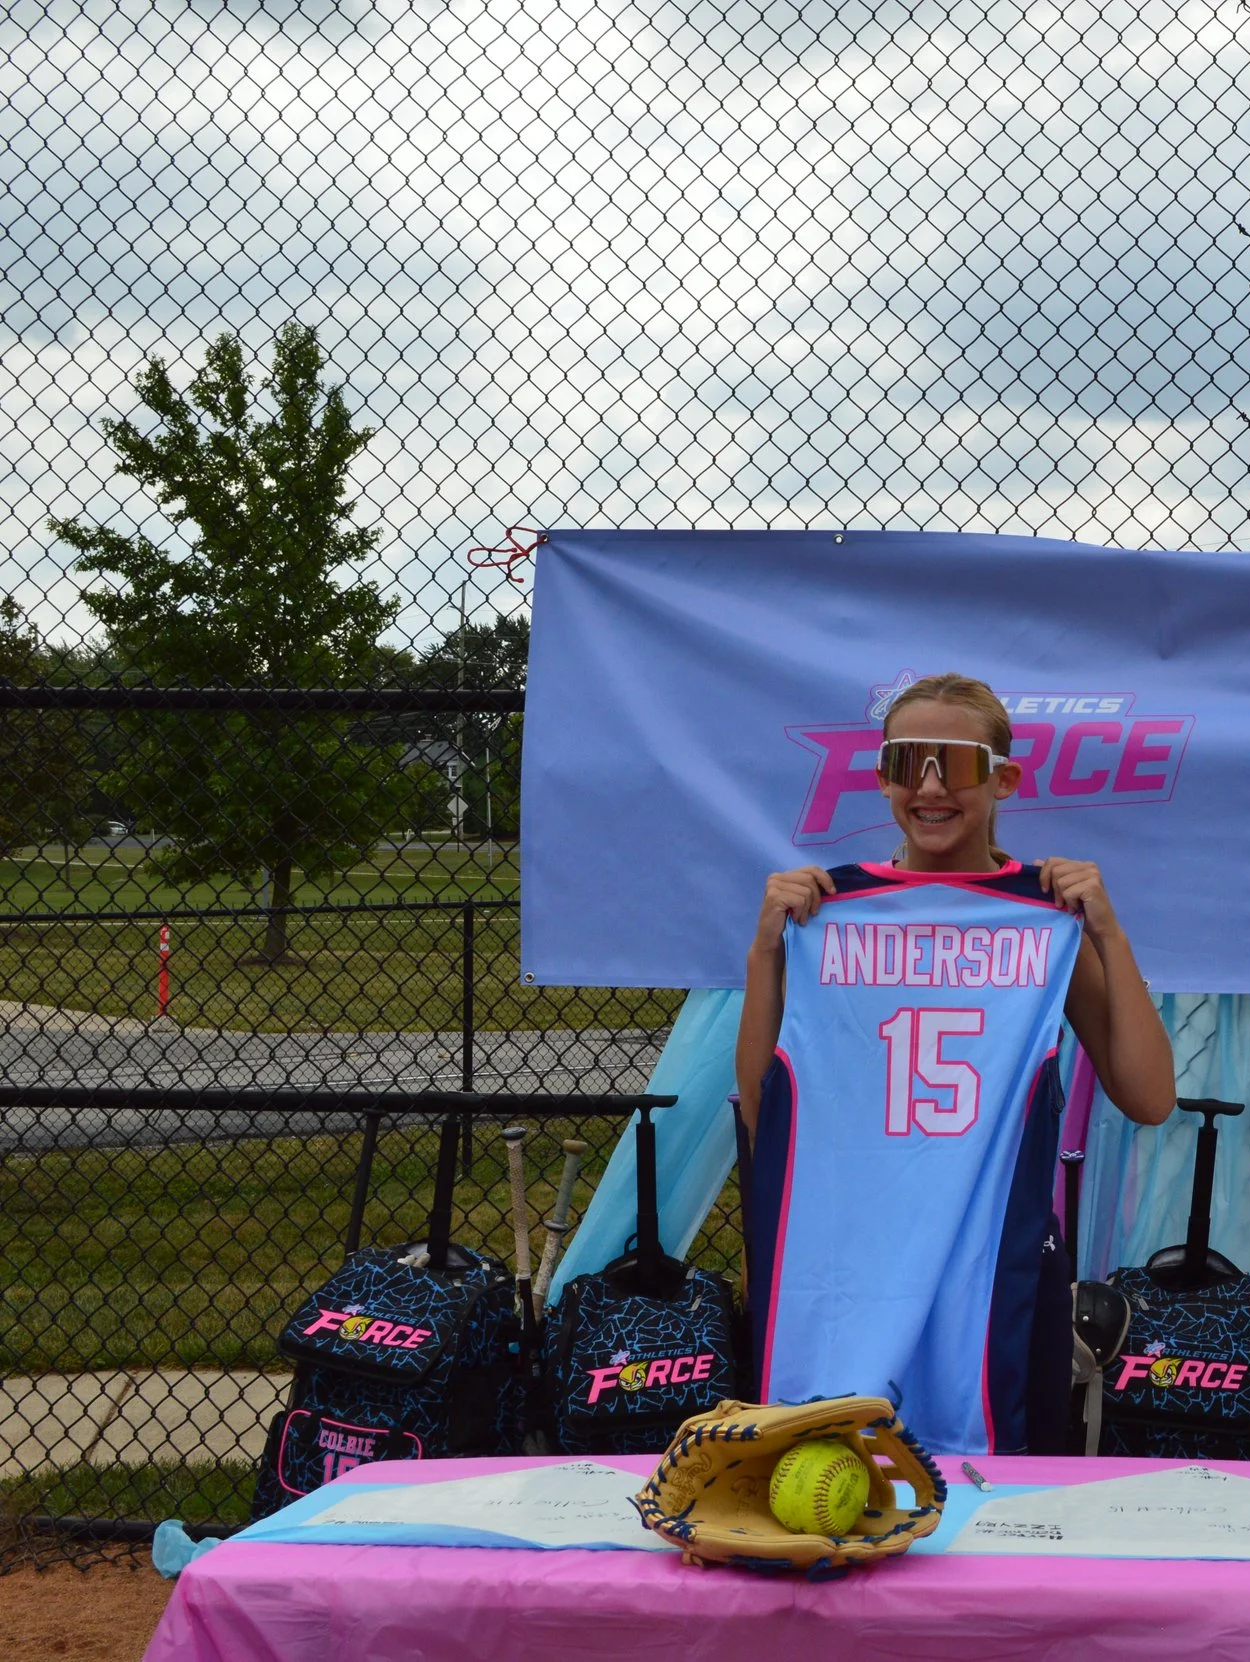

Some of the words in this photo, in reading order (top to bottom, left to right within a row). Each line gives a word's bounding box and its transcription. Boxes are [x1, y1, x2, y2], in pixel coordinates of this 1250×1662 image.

[1001, 697, 1124, 714] LETICS
[802, 720, 1183, 834] FRCE
[820, 921, 1053, 989] ANDERSON
[878, 1006, 985, 1137] 15
[627, 1347, 693, 1361] ATHLETICS
[1161, 1348, 1229, 1361] ATHLETICS
[318, 1429, 377, 1457] COLBIE
